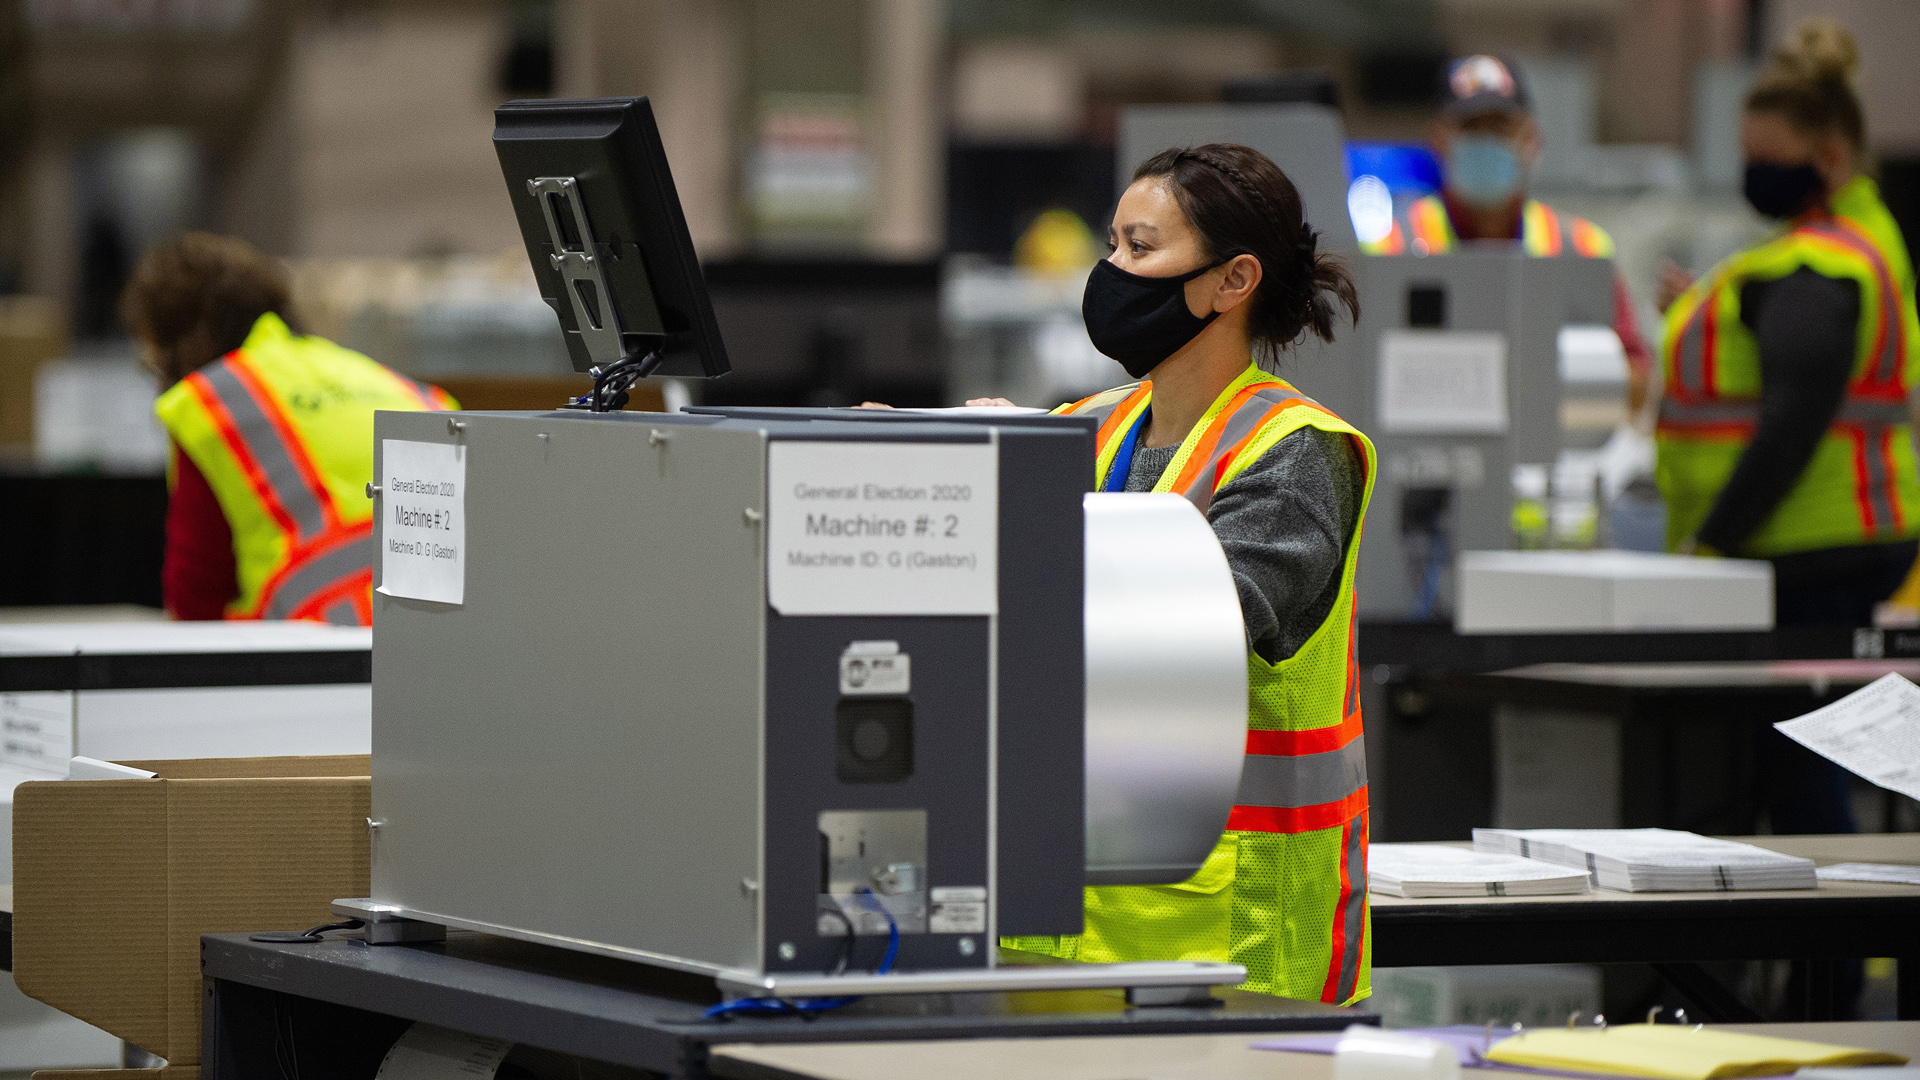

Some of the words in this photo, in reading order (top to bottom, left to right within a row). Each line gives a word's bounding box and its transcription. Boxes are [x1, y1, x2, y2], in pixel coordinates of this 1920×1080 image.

[391, 477, 415, 493] General
[416, 480, 438, 496] Election
[440, 482, 454, 497] 2020
[793, 483, 858, 500] General
[863, 483, 927, 501] Election
[931, 484, 972, 501] 2020
[395, 505, 432, 529] Machine
[434, 509, 442, 530] #:
[444, 510, 450, 531] 2
[806, 513, 906, 537] Machine
[914, 514, 935, 537] #:
[944, 514, 958, 537] 2
[389, 539, 414, 555] Machine
[415, 541, 423, 556] ID:
[425, 543, 431, 557] G
[432, 543, 458, 562] (Gaston)
[787, 551, 855, 567] Machine
[860, 551, 881, 568] ID:
[887, 551, 902, 568] G
[907, 551, 977, 572] (Gaston)
